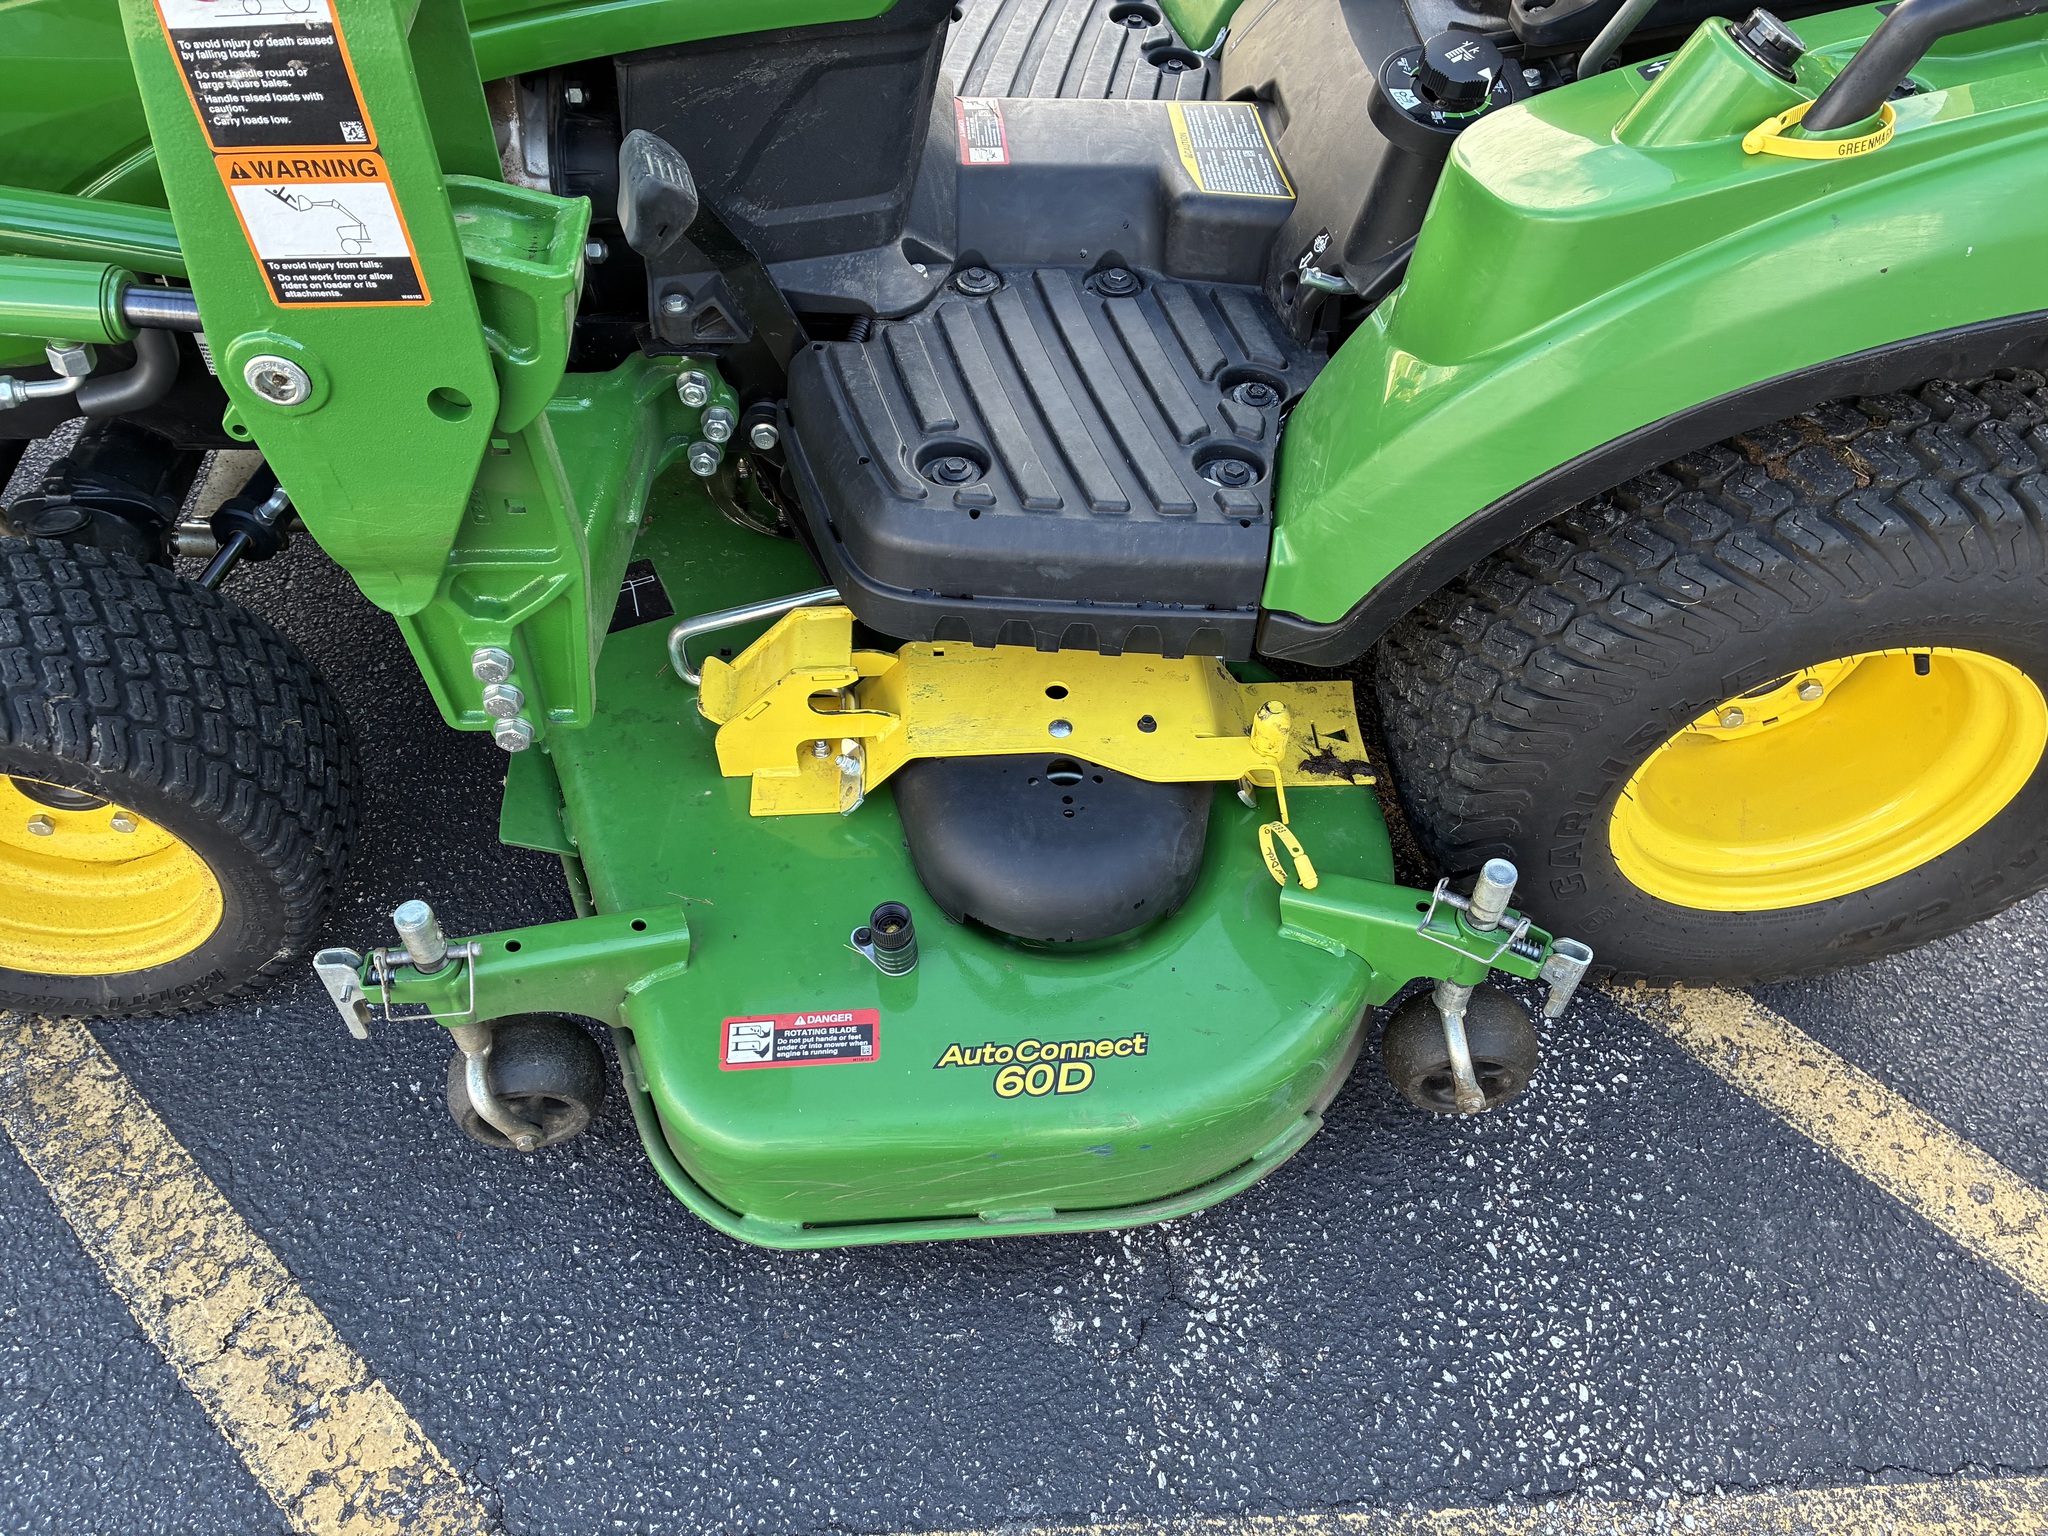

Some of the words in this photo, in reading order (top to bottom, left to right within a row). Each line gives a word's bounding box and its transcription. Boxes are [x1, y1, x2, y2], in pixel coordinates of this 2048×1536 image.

[178, 40, 191, 50] To
[193, 39, 221, 49] avoid
[223, 38, 250, 51] injury
[253, 39, 264, 47] or
[266, 37, 295, 47] death
[297, 35, 333, 46] caused
[181, 51, 194, 61] by
[196, 50, 229, 60] falling
[194, 71, 210, 80] Do
[212, 71, 226, 79] not
[230, 69, 264, 79] handle
[266, 69, 295, 78] round
[297, 69, 308, 77] or
[199, 81, 224, 91] large
[226, 81, 260, 90] square
[262, 79, 292, 88] bales.
[204, 95, 238, 104] Handle
[241, 94, 271, 103] raised
[273, 93, 301, 102] loads
[302, 92, 324, 101] with
[209, 104, 249, 113] caution.
[213, 117, 240, 127] Carry
[242, 116, 269, 124] loads
[270, 116, 292, 124] low.
[249, 158, 378, 179] WARNING
[282, 262, 307, 270] avoid
[309, 262, 335, 271] injury
[360, 261, 383, 269] falls:
[278, 274, 291, 282] Do
[807, 1013, 853, 1024] DANGER
[785, 1029, 827, 1037] ROTATING
[829, 1027, 857, 1035] BLADE
[802, 1037, 814, 1045] put
[933, 1032, 1147, 1069] AutoConnect
[993, 1061, 1095, 1098] 60D
